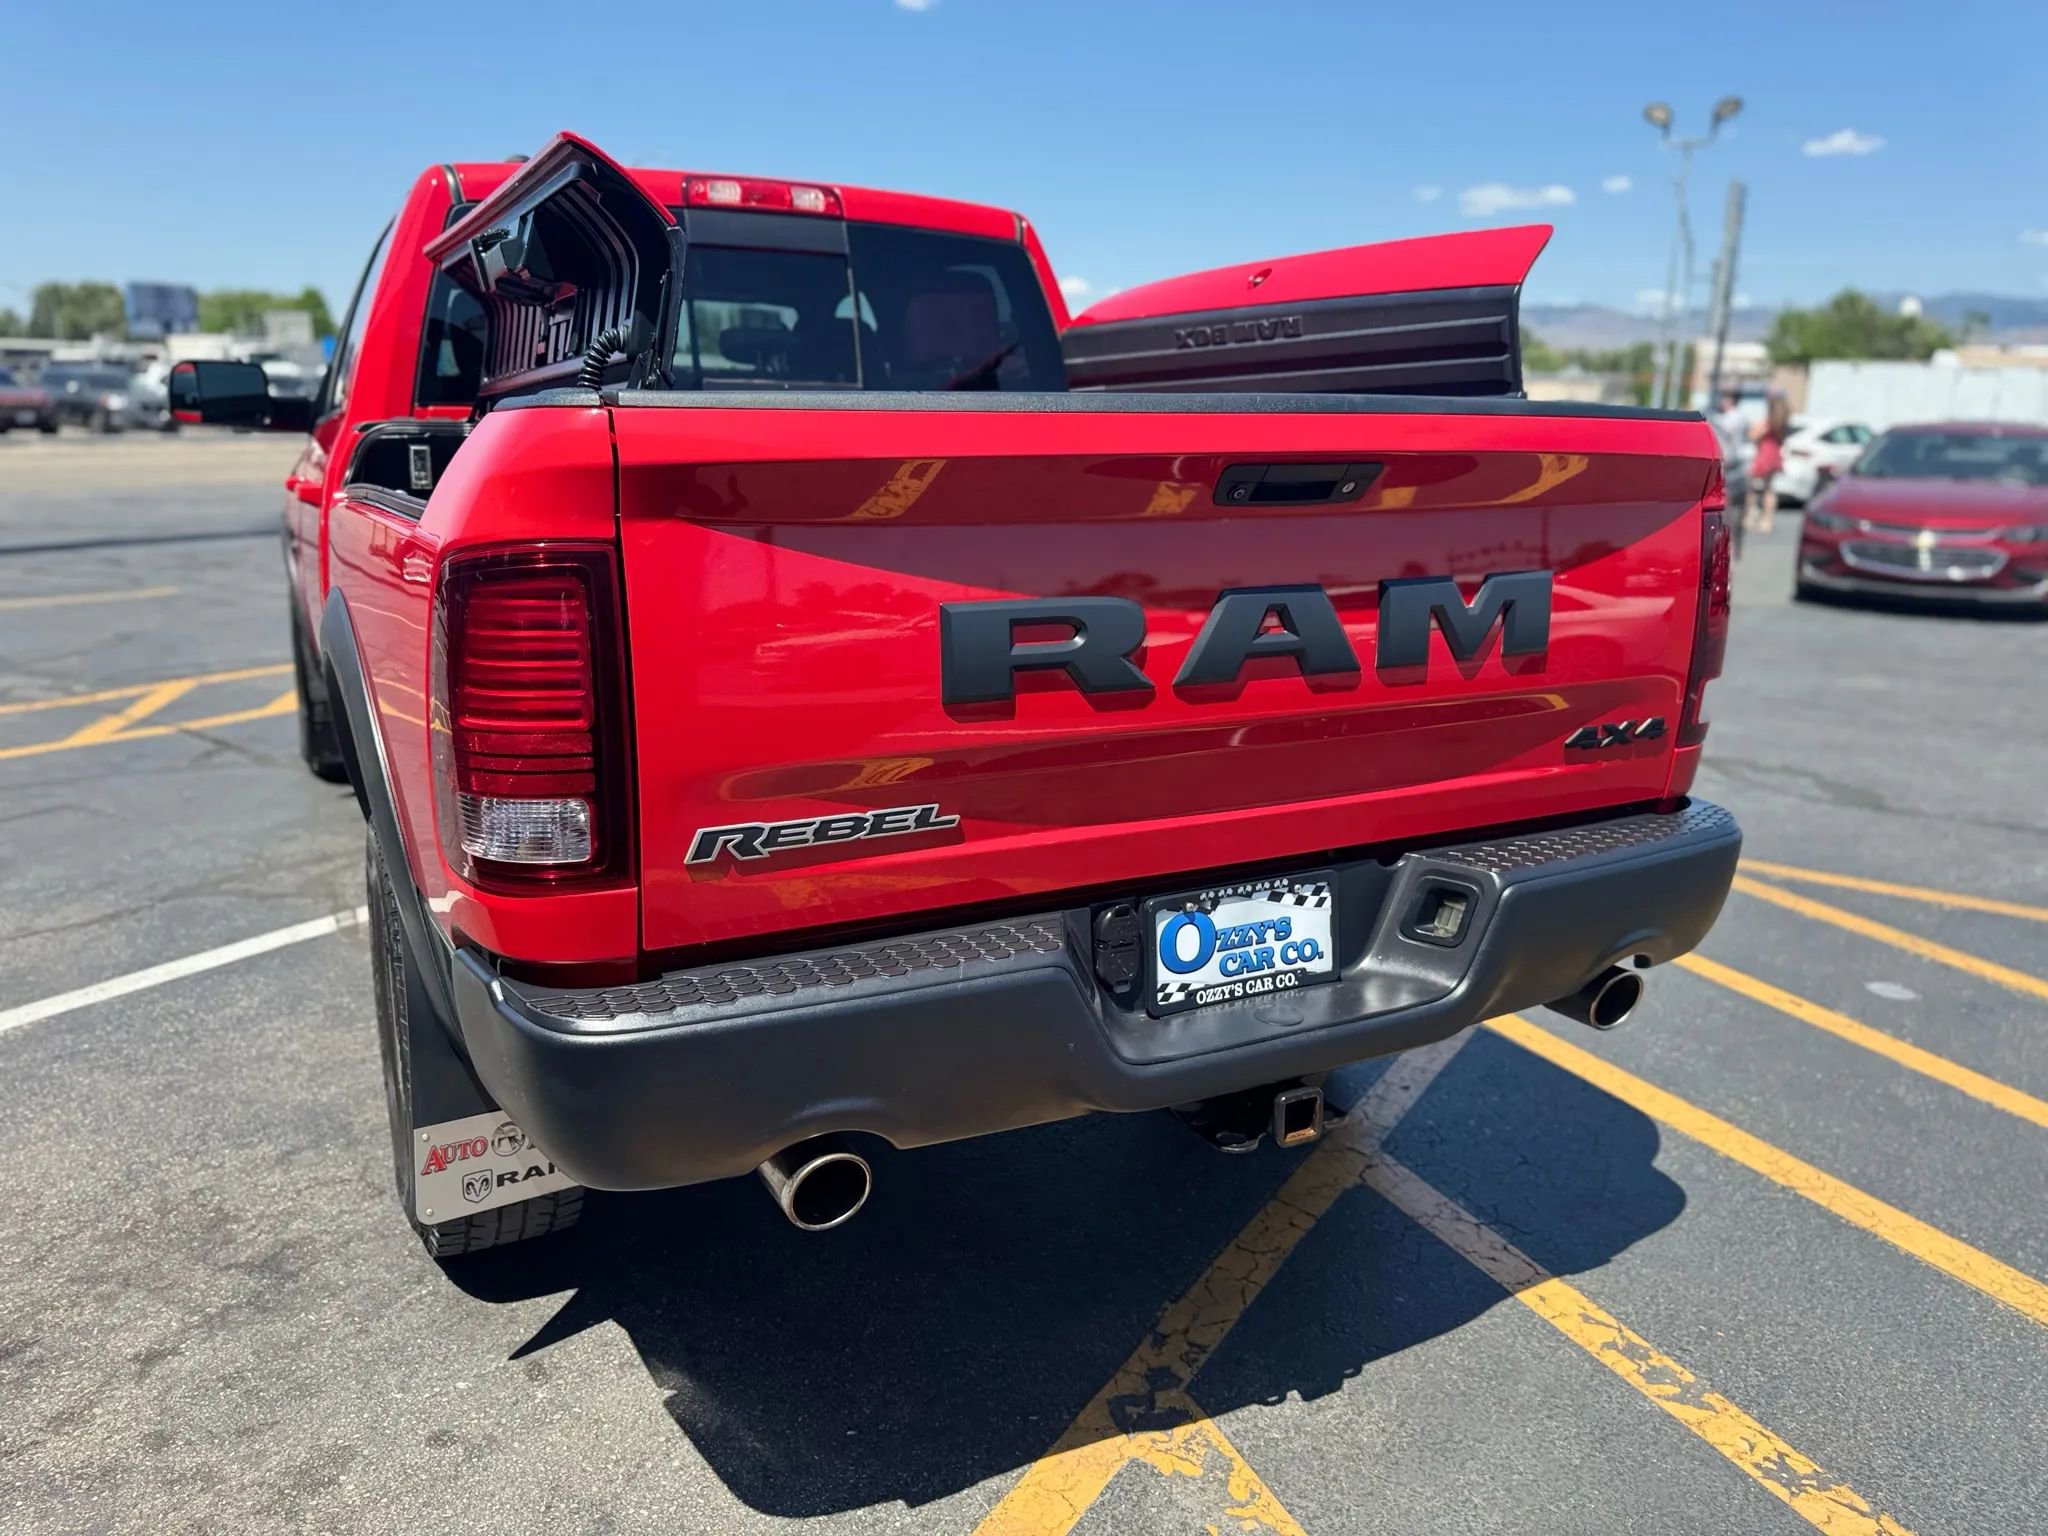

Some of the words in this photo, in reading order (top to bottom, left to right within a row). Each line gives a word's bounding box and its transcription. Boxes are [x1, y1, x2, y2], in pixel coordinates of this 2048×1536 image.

[940, 570, 1554, 706] RAM
[1564, 717, 1668, 750] 4X4
[684, 803, 961, 864] REBEL
[1159, 911, 1292, 974] OZZY'S
[1219, 946, 1275, 977] CAR
[1280, 938, 1324, 965] CO.
[1196, 982, 1243, 1005] OZZY'S
[1245, 976, 1276, 993] CAR
[1276, 972, 1299, 988] CO.
[421, 1136, 489, 1176] AUTO
